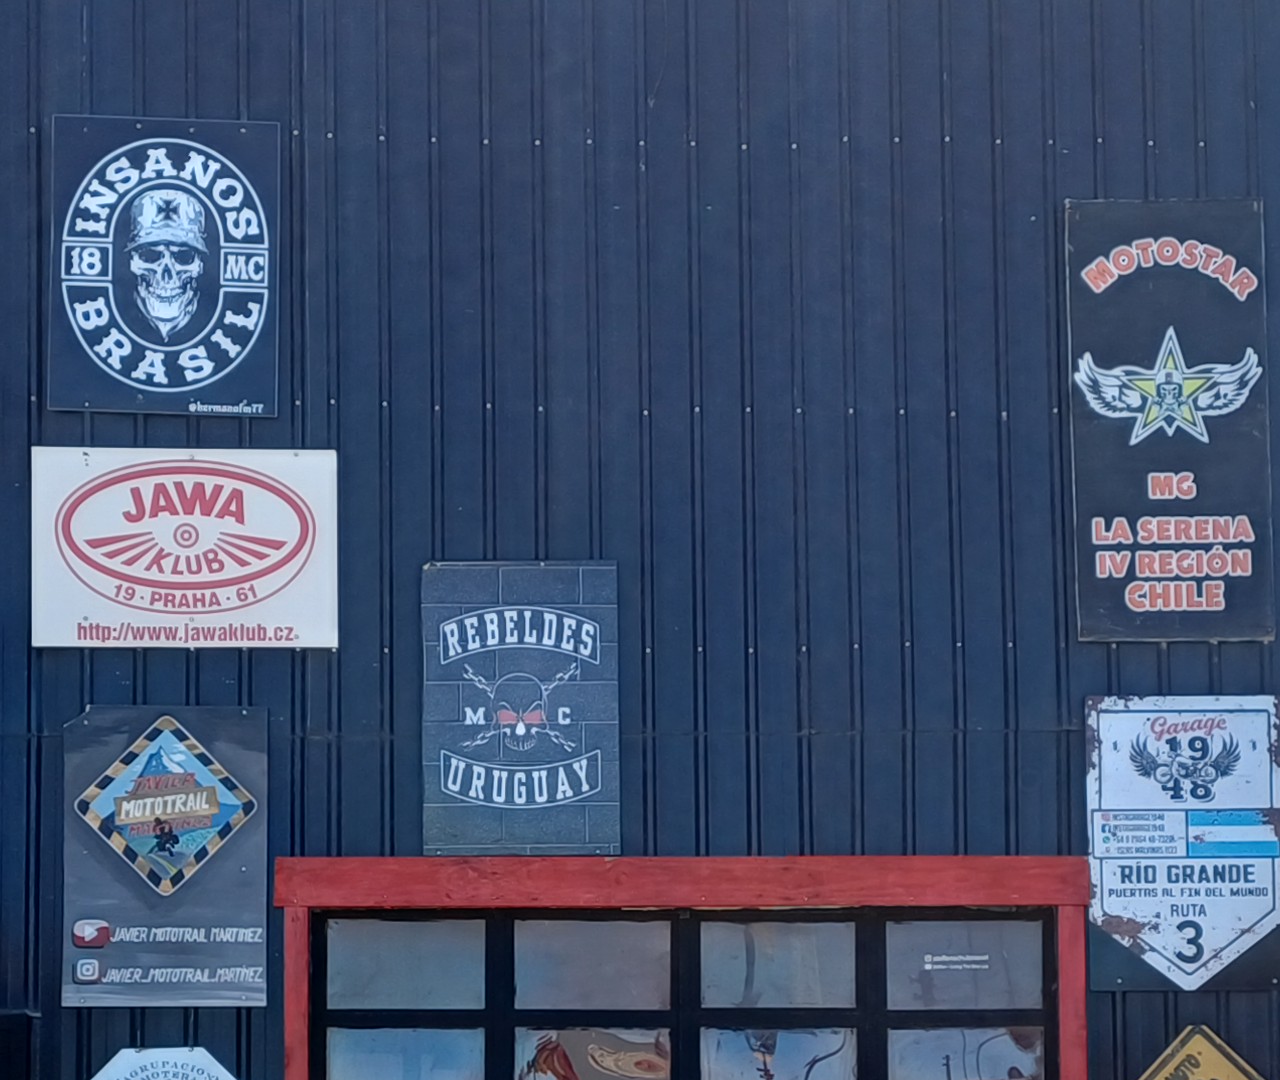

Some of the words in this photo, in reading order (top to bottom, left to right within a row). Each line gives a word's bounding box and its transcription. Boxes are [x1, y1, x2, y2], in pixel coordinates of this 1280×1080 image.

[75, 147, 260, 240] INSANOS
[70, 247, 102, 275] 18
[224, 254, 265, 281] MC
[1080, 236, 1258, 301] MOTOSTAR
[73, 296, 261, 384] BRASIL
[1148, 472, 1196, 499] MG
[122, 481, 245, 526] JAWA
[1092, 517, 1133, 544] LA
[1137, 515, 1255, 543] SERENA
[144, 547, 225, 575] KLUB
[1096, 552, 1130, 578] IV
[1135, 545, 1252, 578] REGIÓN
[113, 583, 136, 601] 19
[150, 590, 222, 609] PRAHA
[236, 583, 259, 601] 61
[1125, 581, 1226, 611] CHILE
[77, 622, 295, 643] http://www.jawaklub.cz
[444, 610, 596, 657] REBELDES
[464, 707, 486, 725] M
[558, 707, 571, 725] C
[1150, 716, 1228, 741] Garage
[447, 758, 590, 804] URUGUAY
[120, 791, 210, 819] MOTOTRAIL
[1167, 864, 1256, 883] GRANDE
[1108, 888, 1158, 898] PUERTAS
[1162, 887, 1176, 898] AL
[1180, 887, 1201, 898] FIN
[1205, 887, 1226, 897] DEL
[1230, 887, 1269, 897] MUNDO
[1170, 904, 1207, 918] RUTA
[110, 927, 148, 942] JAVIER
[149, 926, 207, 942] MOTOTRAIL
[1176, 920, 1205, 964] 3
